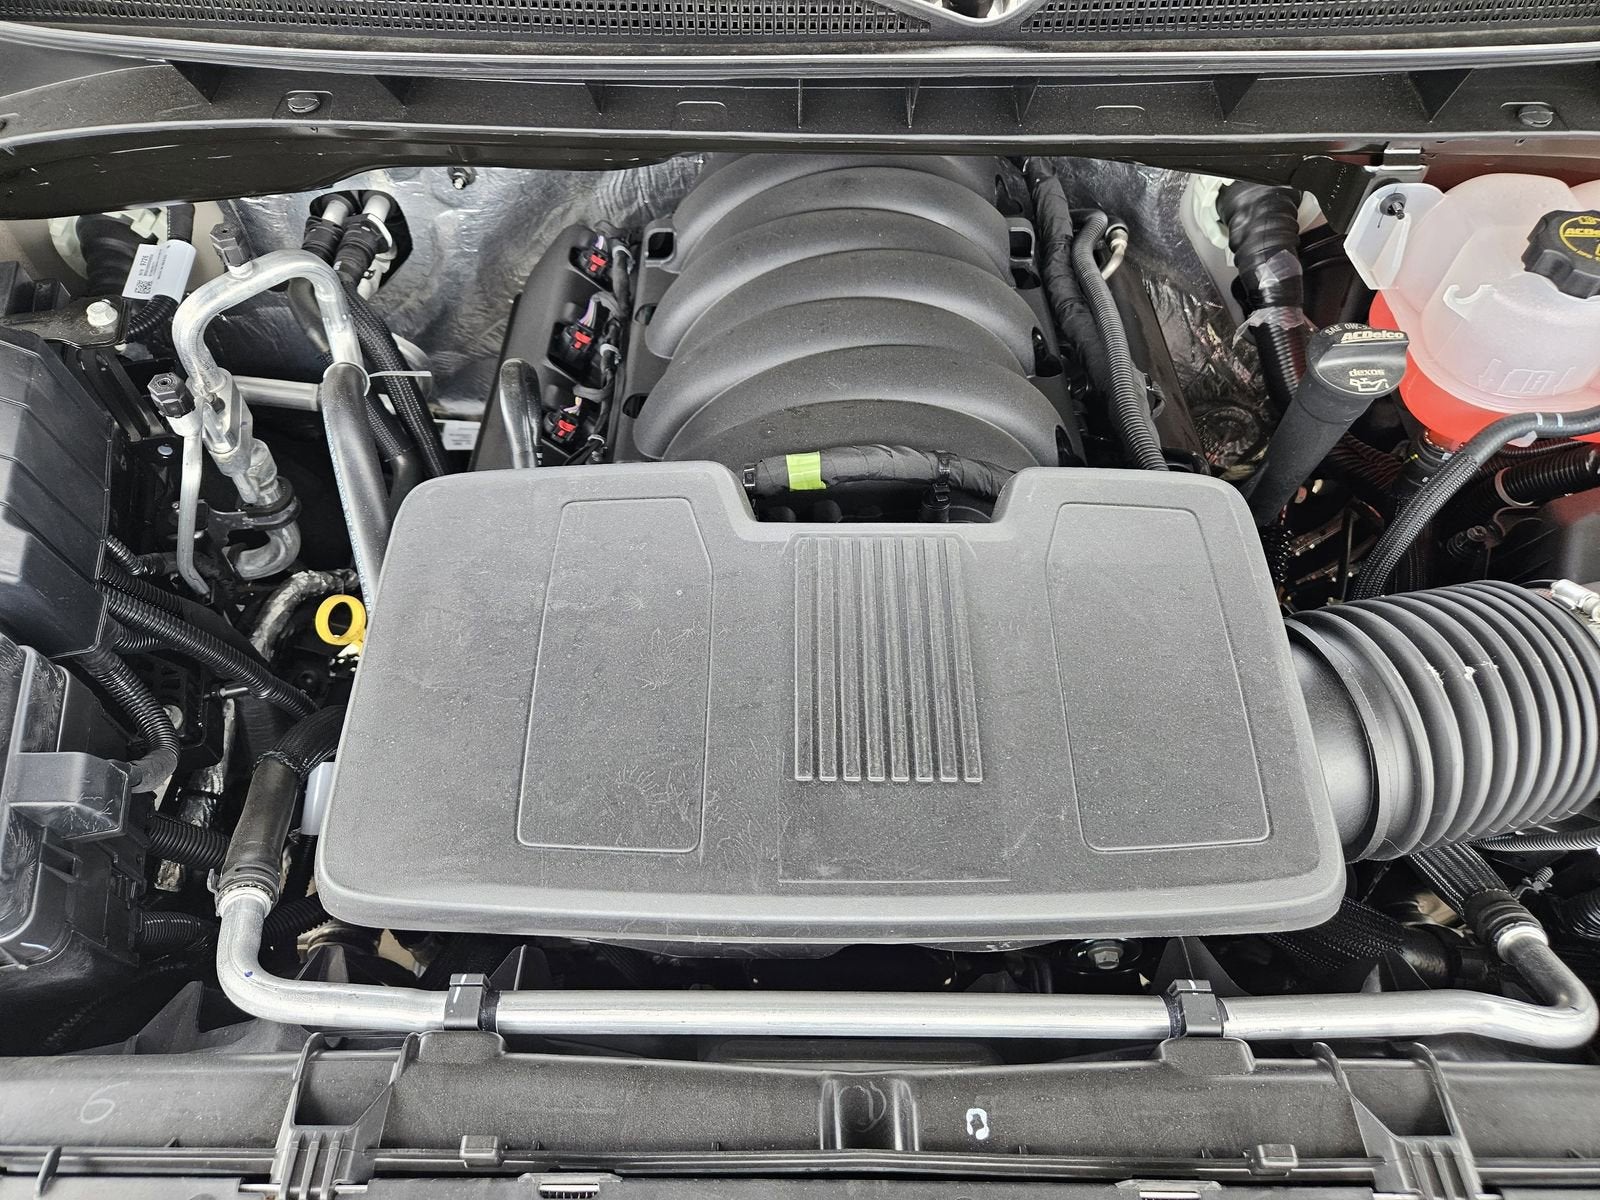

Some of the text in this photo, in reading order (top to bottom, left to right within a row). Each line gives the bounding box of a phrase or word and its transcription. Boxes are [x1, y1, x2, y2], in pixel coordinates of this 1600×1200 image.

[1325, 324, 1343, 336] SAE
[1341, 330, 1405, 342] ACDelco
[1348, 368, 1386, 377] dexos
